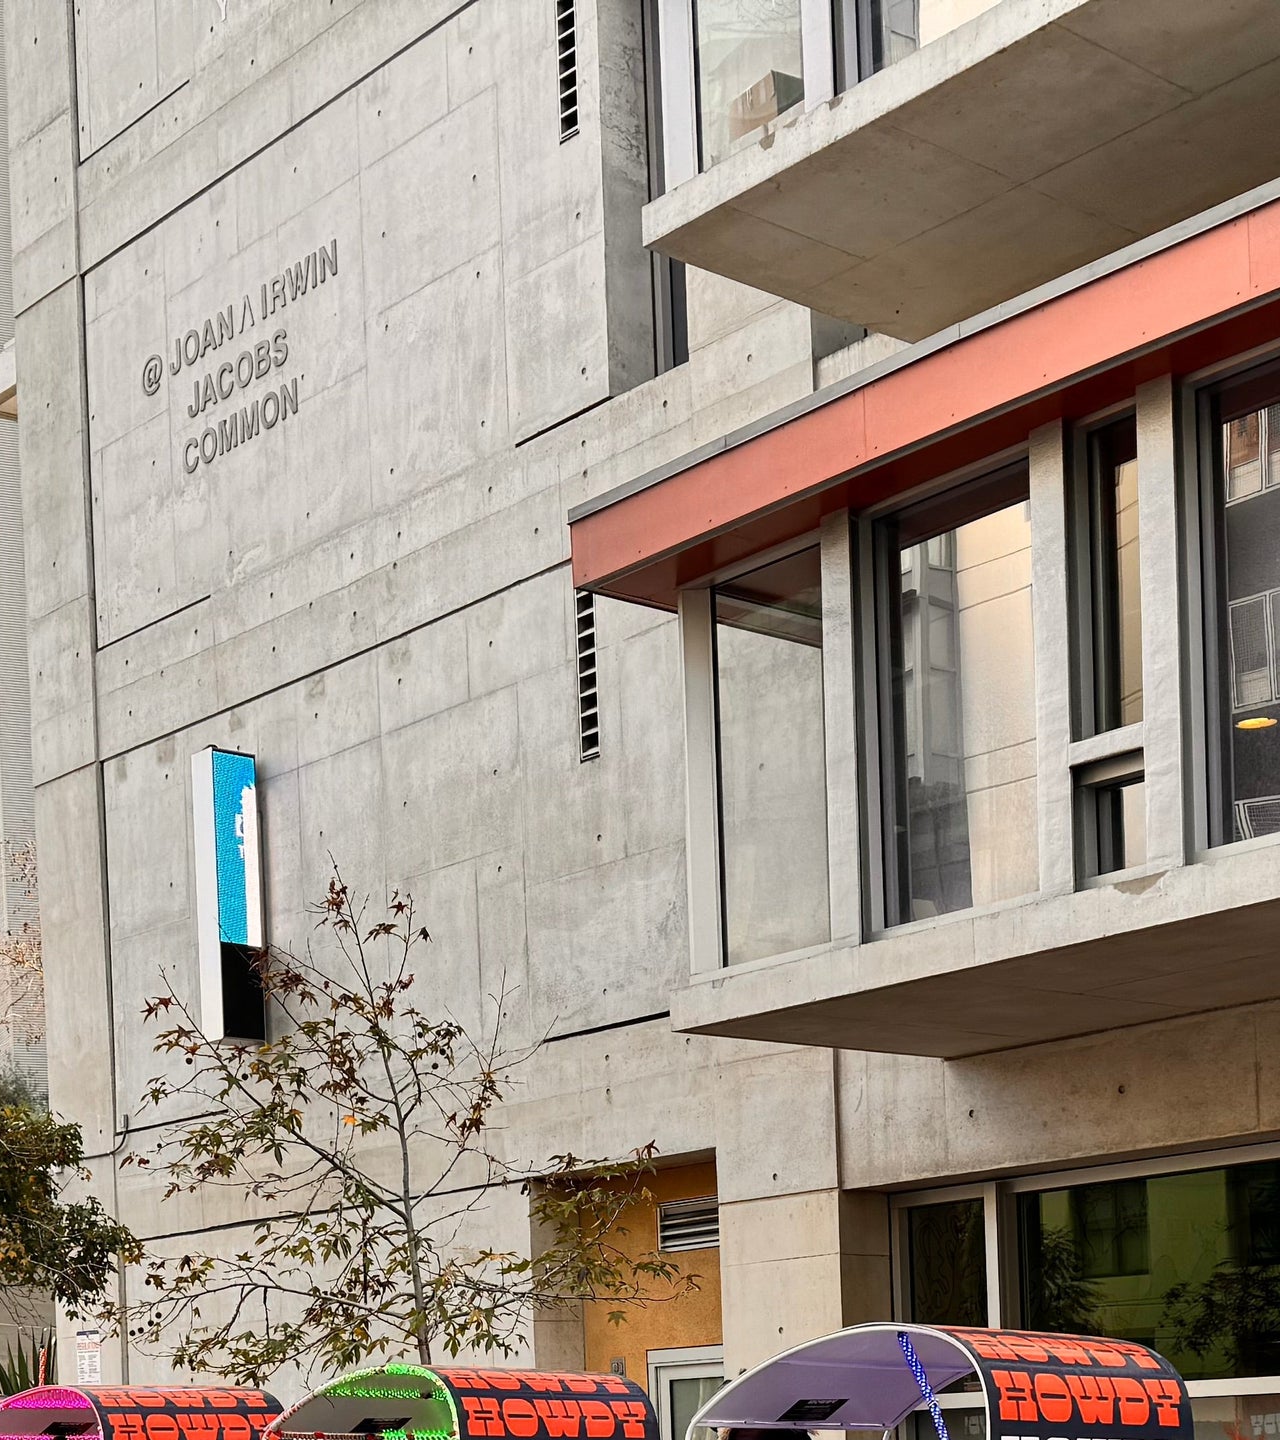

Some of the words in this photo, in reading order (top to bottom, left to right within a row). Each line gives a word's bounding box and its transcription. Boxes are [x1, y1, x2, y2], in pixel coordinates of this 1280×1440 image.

[142, 354, 163, 396] @
[170, 304, 234, 376] JOAN
[261, 238, 338, 320] IRWIN
[187, 328, 289, 418] JACOBS
[183, 377, 299, 474] COMMON
[956, 1332, 1161, 1370] HOWDY
[94, 1391, 268, 1409] HOWDY
[445, 1369, 631, 1393] HOWDY
[990, 1369, 1182, 1427] HOWDY
[461, 1397, 647, 1439] HOWDY
